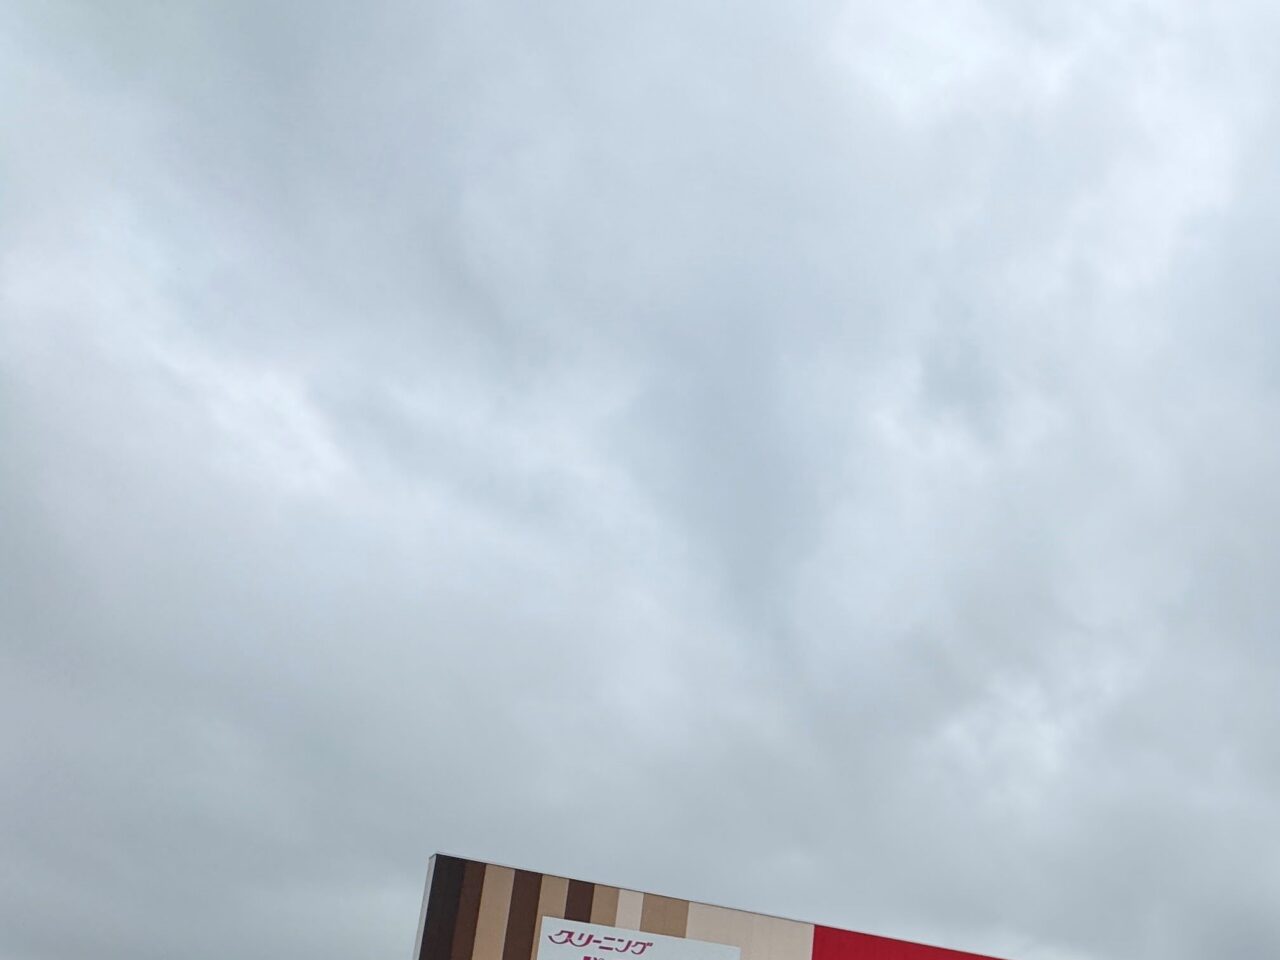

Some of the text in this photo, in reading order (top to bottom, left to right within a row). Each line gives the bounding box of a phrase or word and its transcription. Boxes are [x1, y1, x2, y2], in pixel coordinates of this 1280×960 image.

[547, 929, 654, 954] クリーニング
